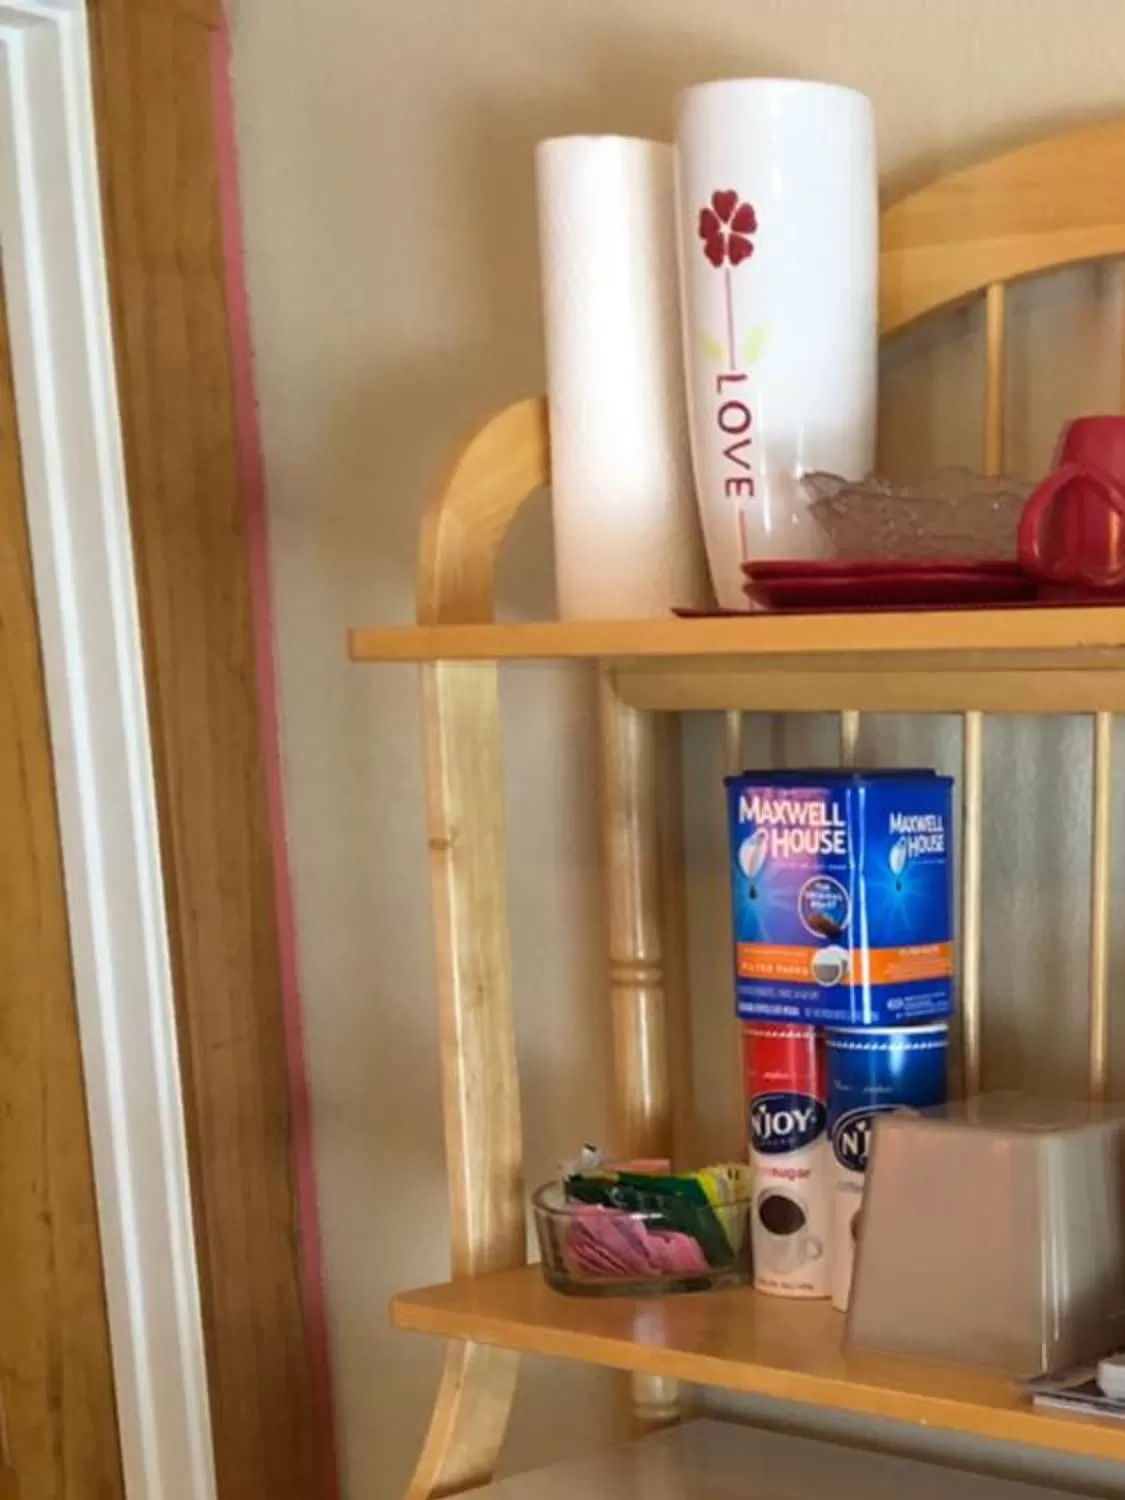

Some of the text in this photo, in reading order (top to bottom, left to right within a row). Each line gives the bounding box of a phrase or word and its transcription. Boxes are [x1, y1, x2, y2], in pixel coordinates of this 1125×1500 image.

[716, 373, 755, 498] LOVE
[738, 795, 846, 826] MAXWELL
[889, 811, 944, 834] MAXWELL
[771, 828, 847, 858] HOUSE
[907, 834, 944, 857] HOUSE
